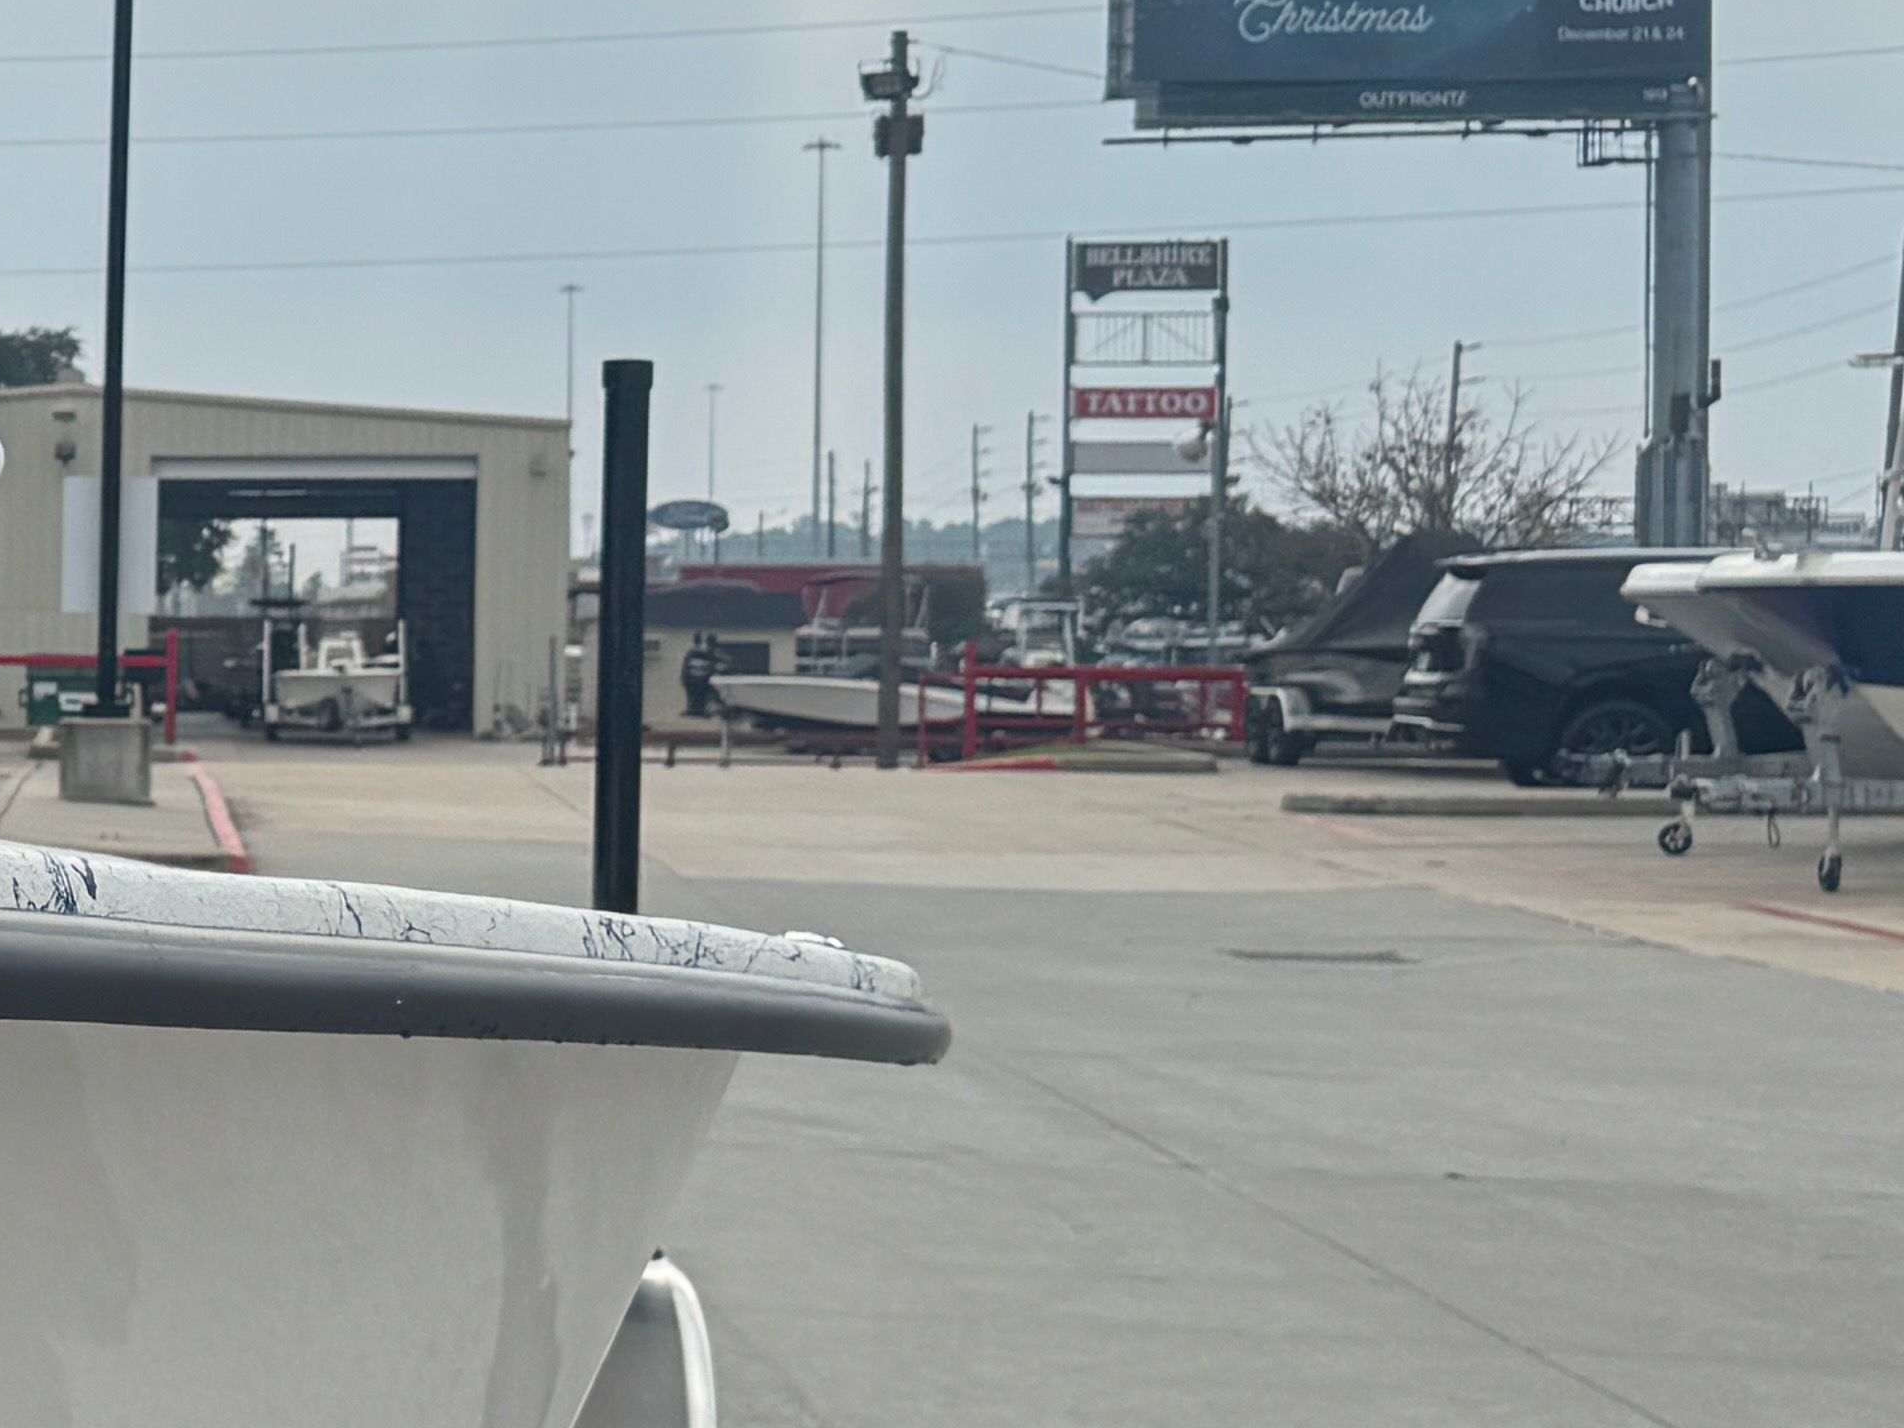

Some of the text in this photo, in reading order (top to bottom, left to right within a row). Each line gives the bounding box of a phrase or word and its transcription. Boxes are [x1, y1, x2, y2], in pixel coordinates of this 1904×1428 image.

[1557, 25, 1629, 42] December
[1112, 268, 1189, 287] PLAZA
[1086, 391, 1208, 414] TATTOO
